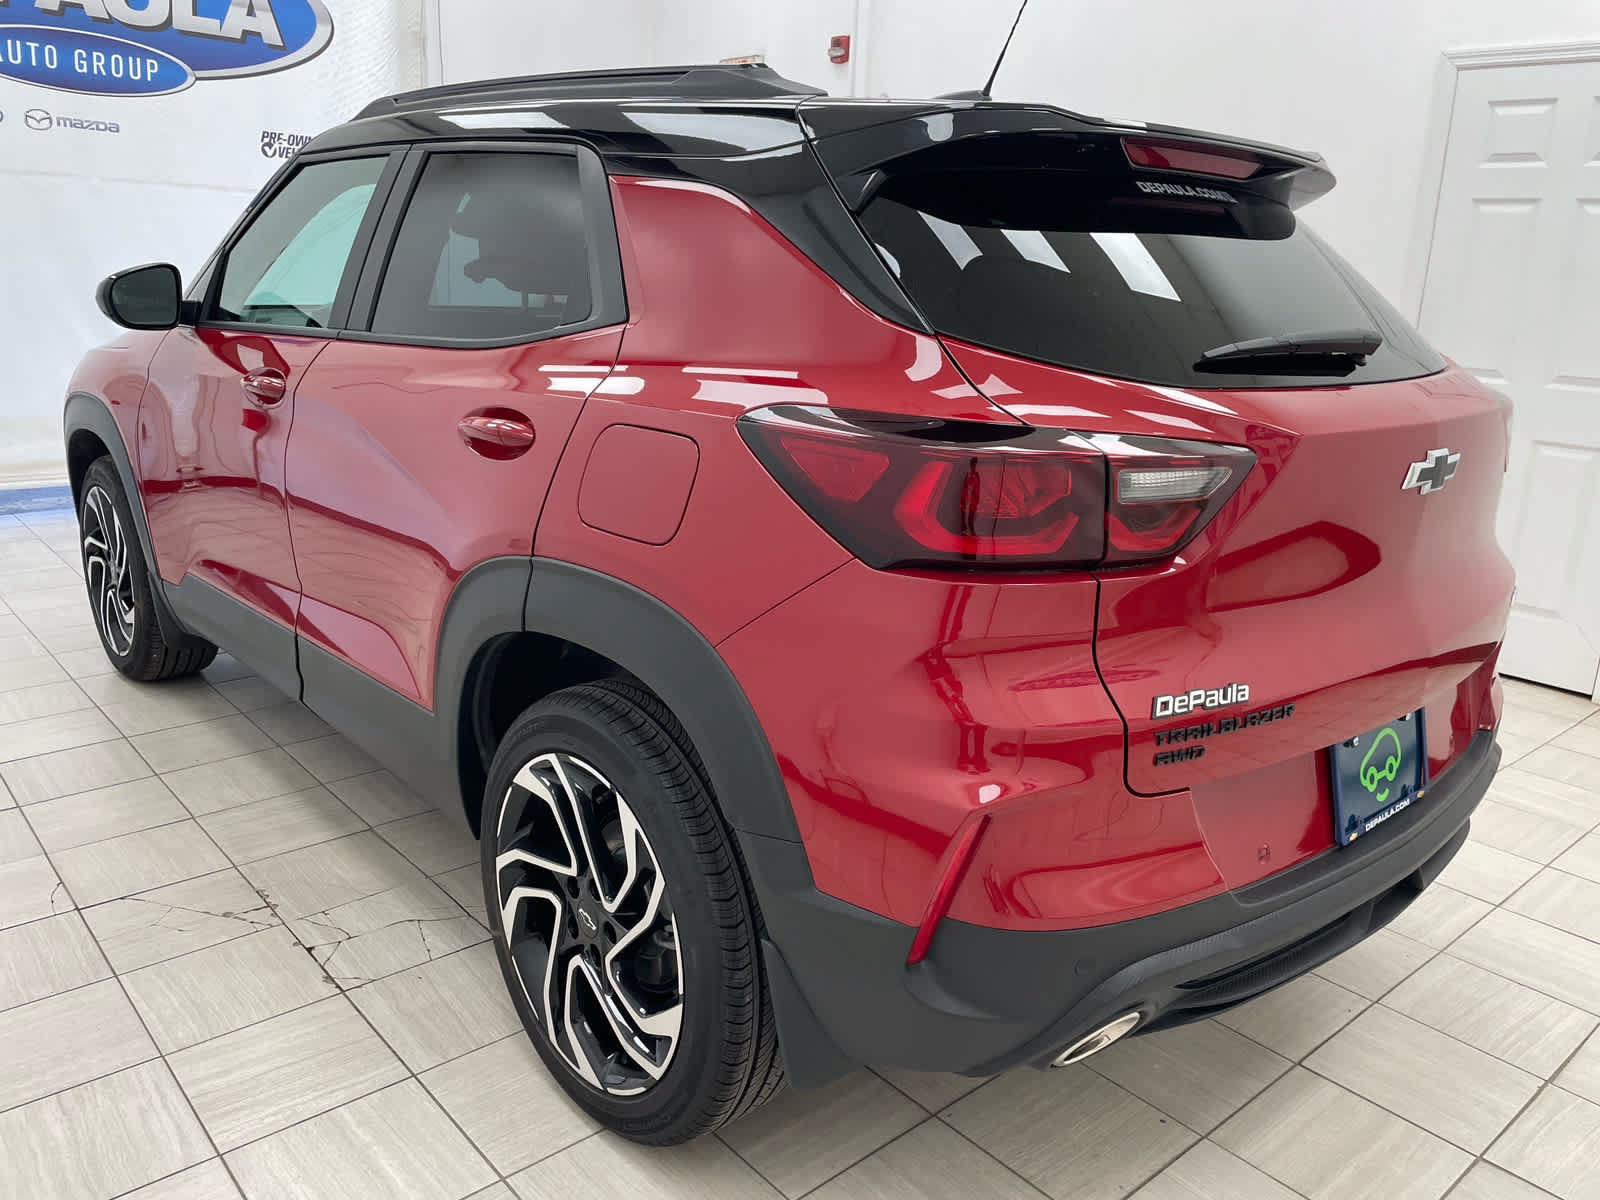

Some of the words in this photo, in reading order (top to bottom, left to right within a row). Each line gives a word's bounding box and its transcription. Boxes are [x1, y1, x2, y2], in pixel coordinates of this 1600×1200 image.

[73, 48, 159, 82] GROUP
[278, 146, 296, 159] VE
[1153, 682, 1250, 718] DePaula
[1153, 703, 1295, 746] TRAILBLAZER
[1365, 798, 1411, 832] DEPAULA.COM
